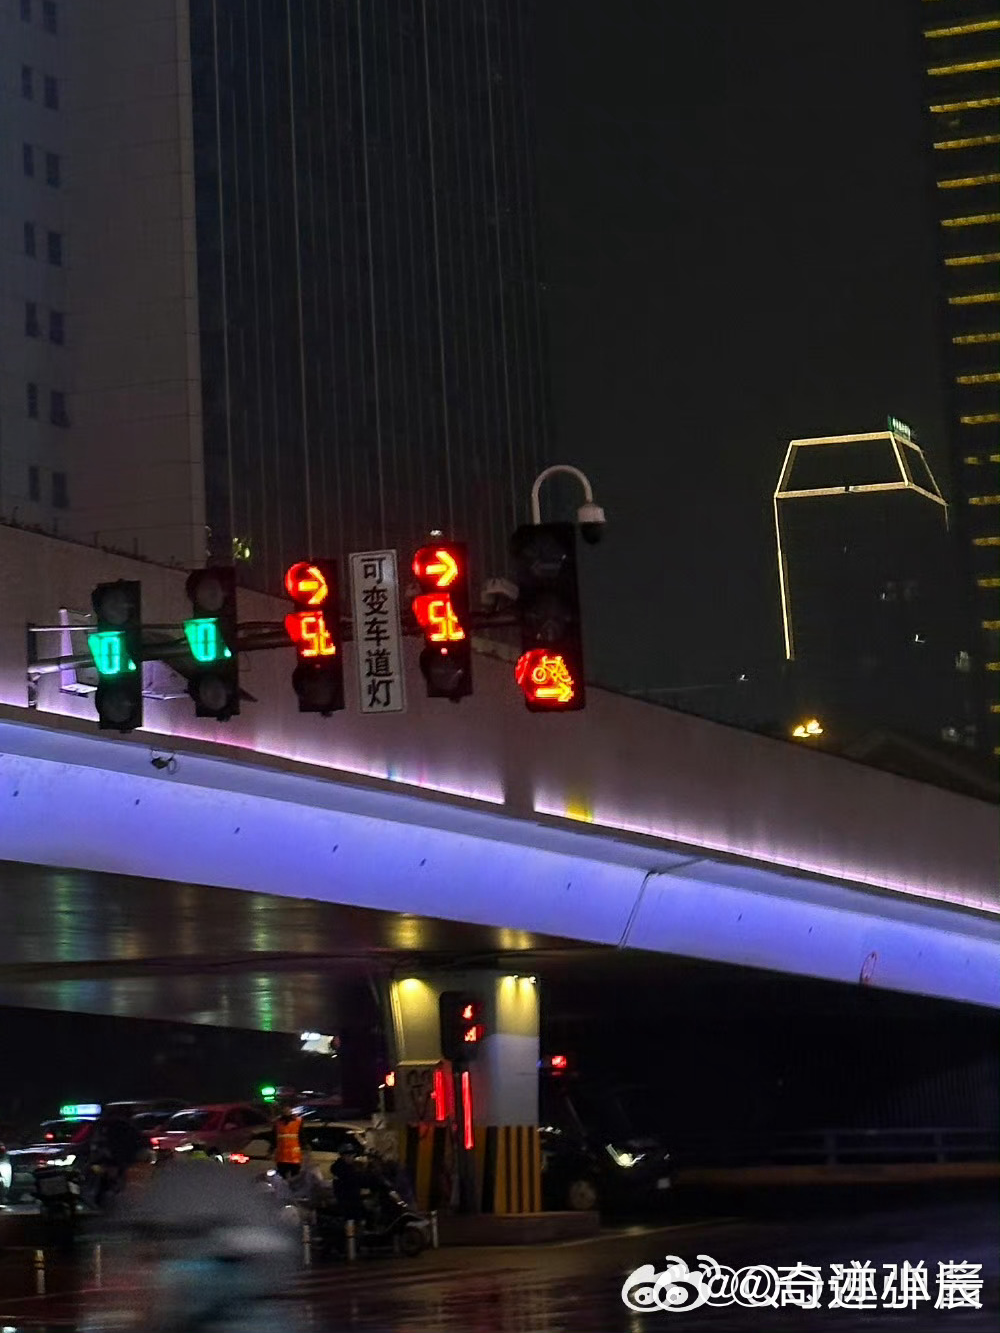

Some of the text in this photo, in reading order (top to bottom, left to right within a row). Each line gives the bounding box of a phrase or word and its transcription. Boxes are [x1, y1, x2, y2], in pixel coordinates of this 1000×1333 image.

[361, 557, 394, 707] 可变车道灯
